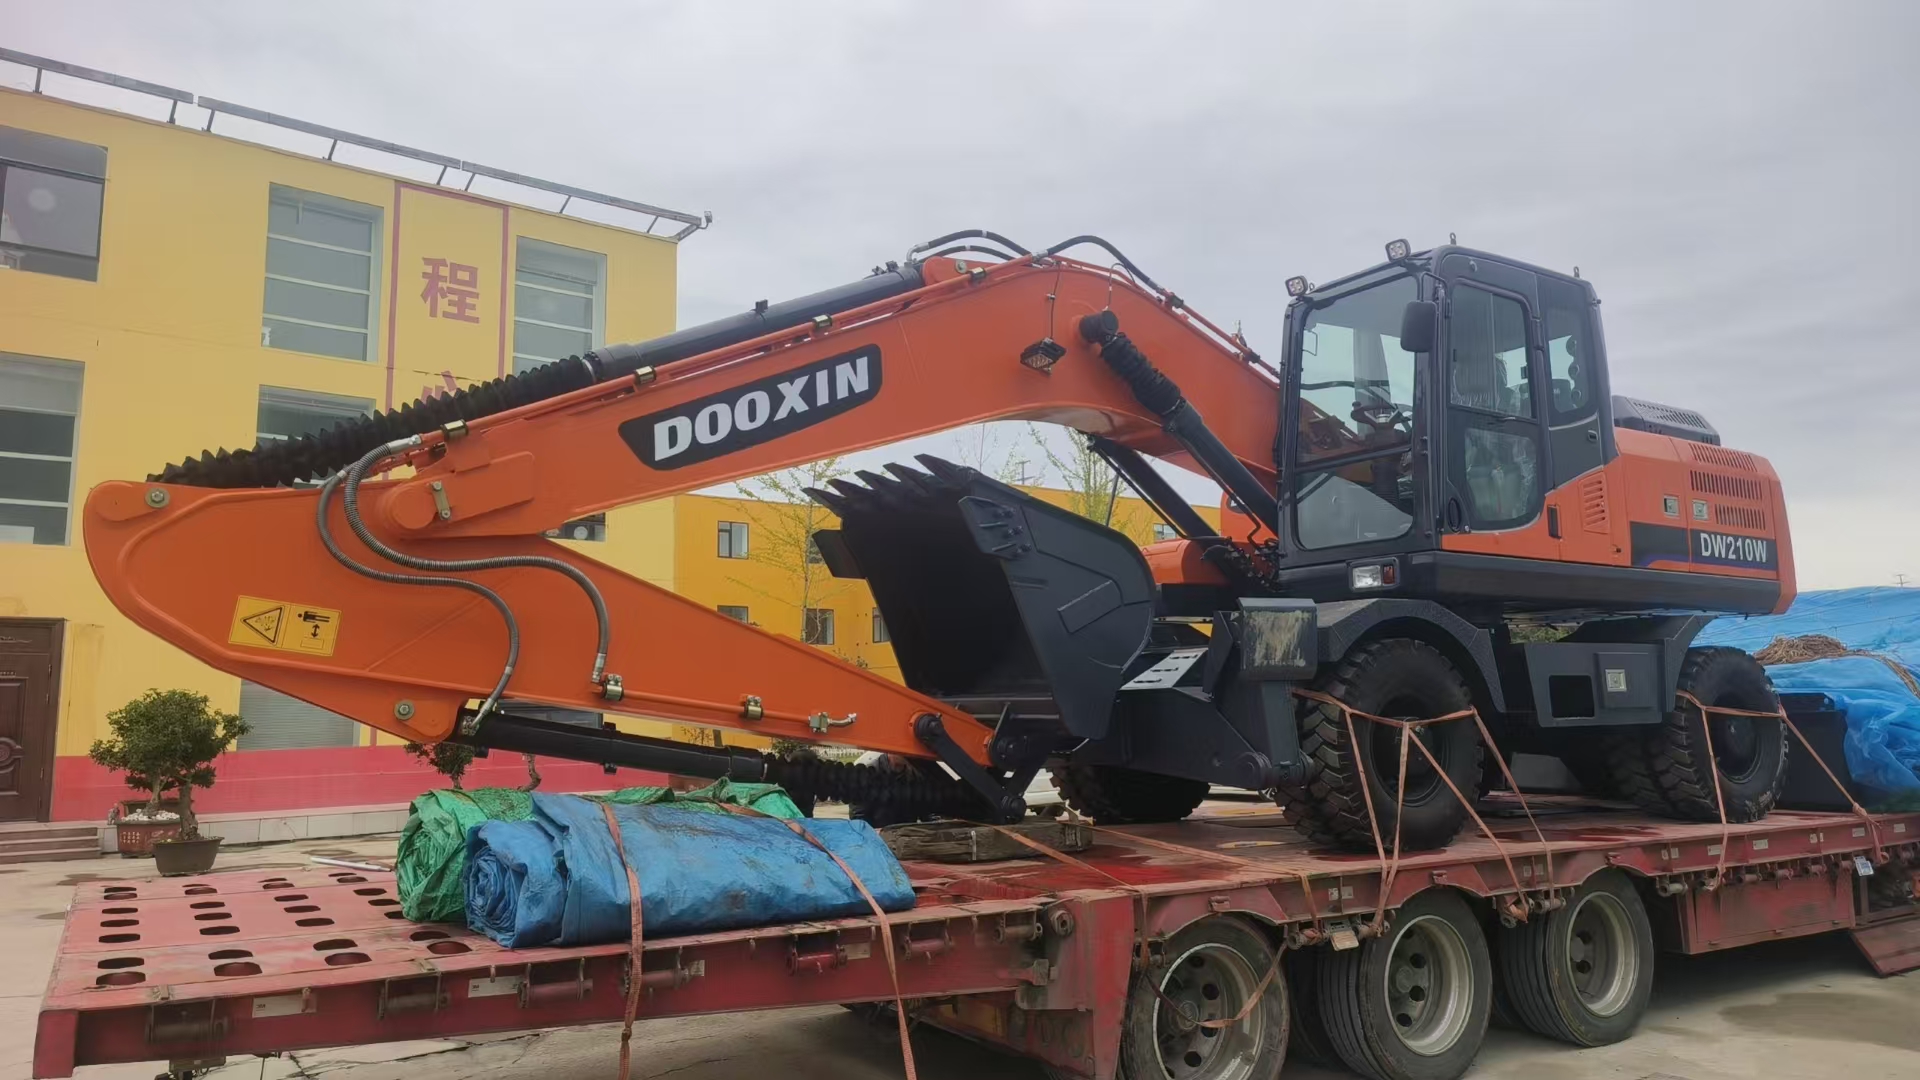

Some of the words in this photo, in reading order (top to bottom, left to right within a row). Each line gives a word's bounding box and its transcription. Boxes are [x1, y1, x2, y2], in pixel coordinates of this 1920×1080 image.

[420, 257, 480, 324] 程
[654, 356, 869, 461] DOOXIN
[1700, 532, 1767, 563] DW210W
